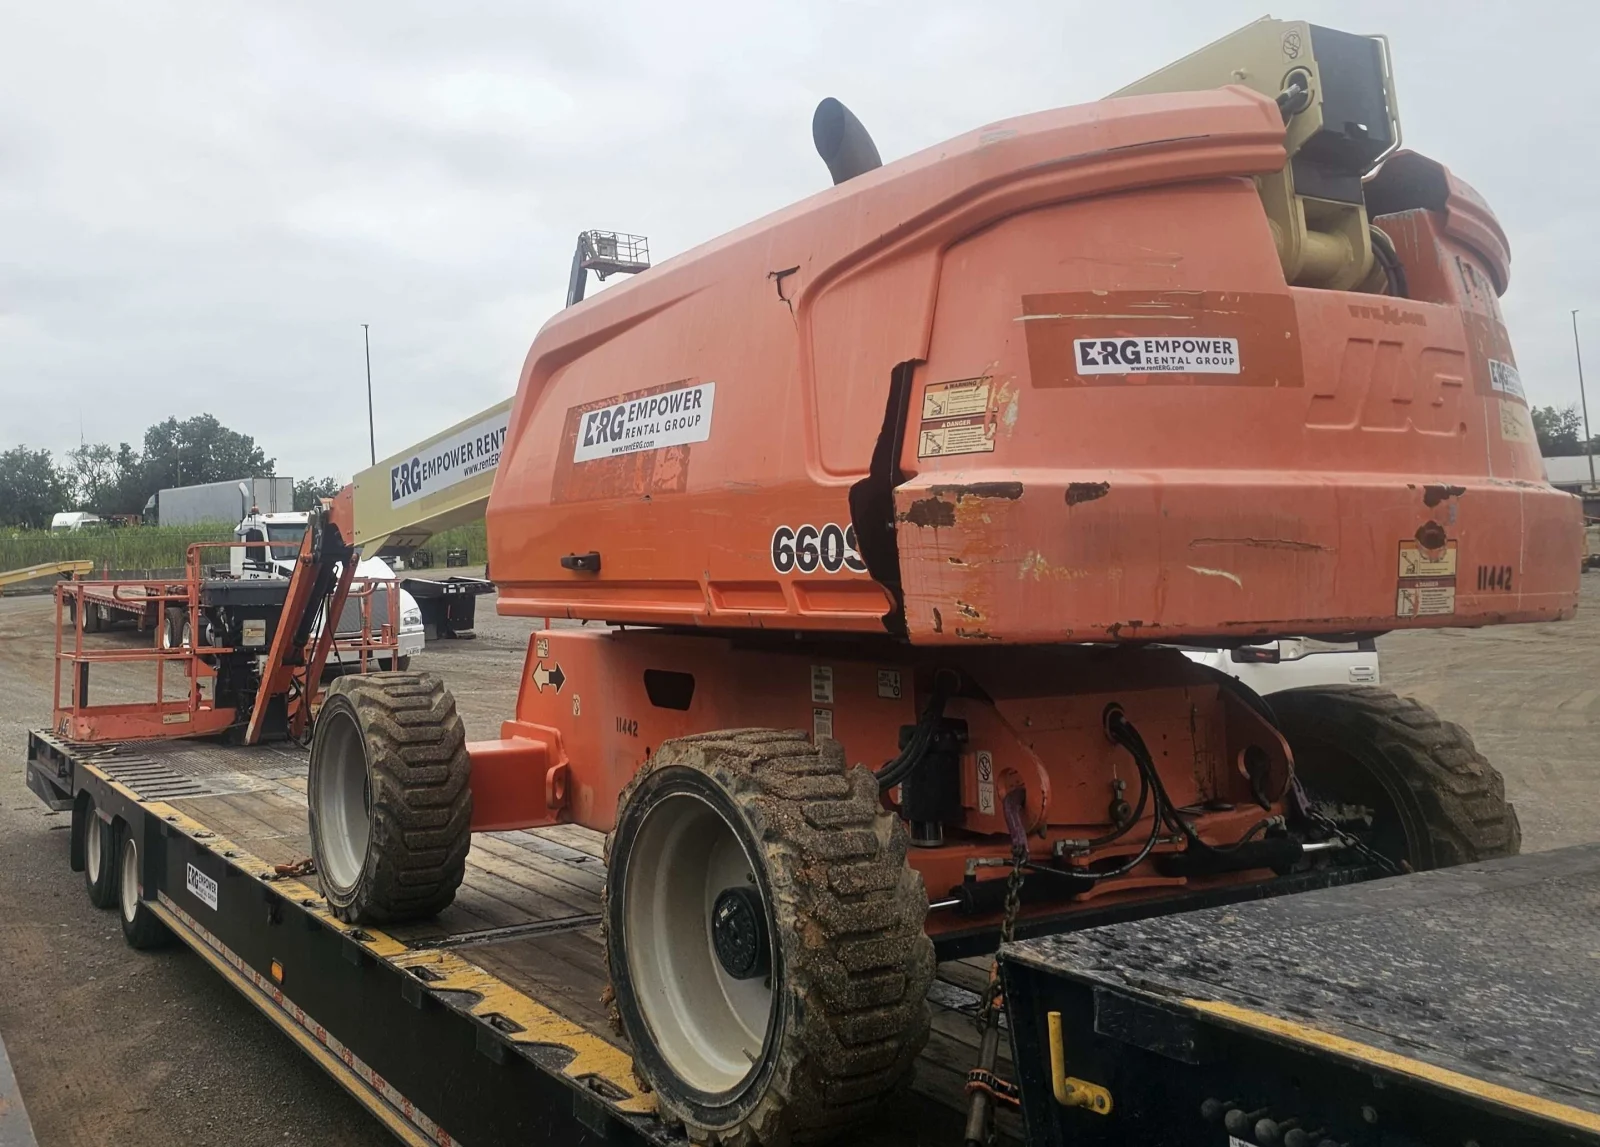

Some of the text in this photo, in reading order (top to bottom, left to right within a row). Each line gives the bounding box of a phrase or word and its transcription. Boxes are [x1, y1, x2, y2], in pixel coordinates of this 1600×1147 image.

[1080, 340, 1141, 365] ERG
[1144, 340, 1233, 354] EMPOWER
[1146, 356, 1235, 365] RENTAL GROUP
[950, 380, 977, 389] WARNING
[628, 388, 702, 422] EMPOWER
[583, 405, 626, 447] ERG
[625, 414, 701, 439] RENTAL GROUP
[946, 419, 971, 428] DANGER
[611, 439, 655, 454] www.rentERG.com
[391, 457, 422, 501] ERG
[422, 442, 474, 481] EMPOWER
[464, 451, 502, 477] www.rentER
[1477, 566, 1512, 591] 11442
[616, 716, 638, 738] 11442
